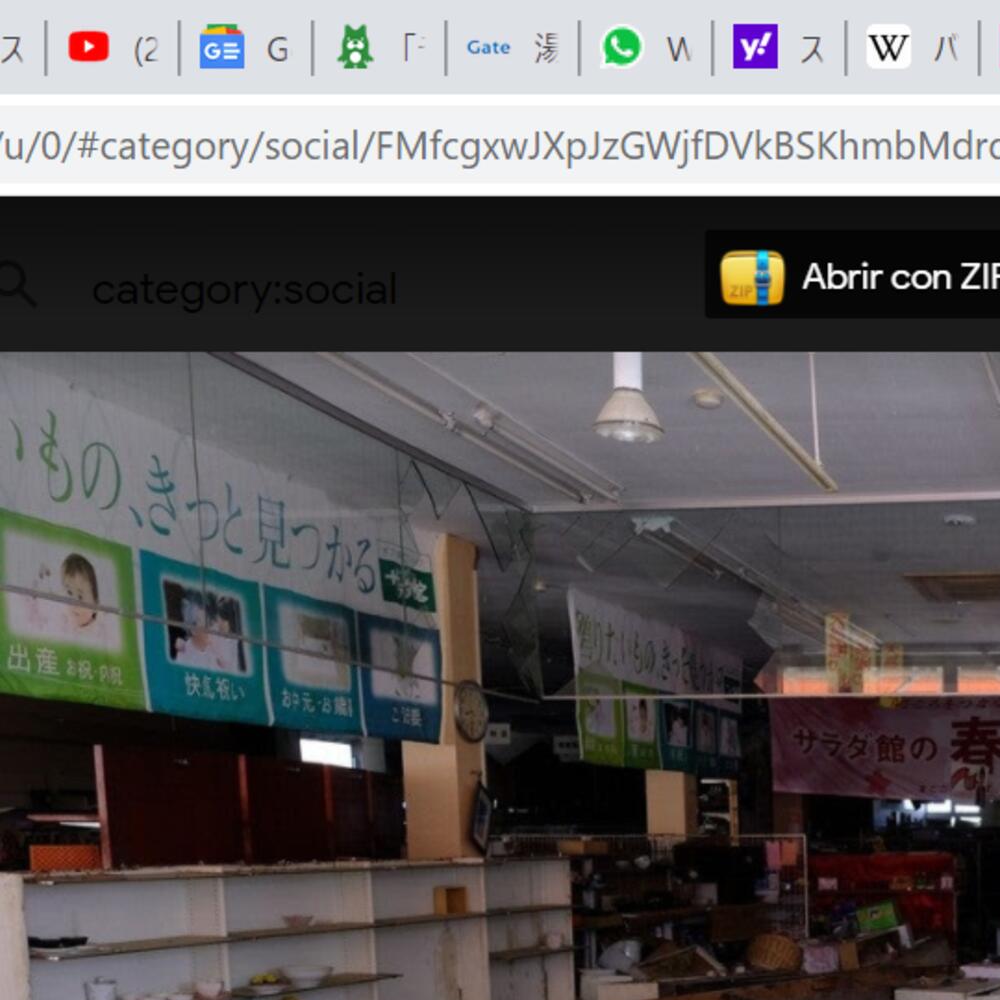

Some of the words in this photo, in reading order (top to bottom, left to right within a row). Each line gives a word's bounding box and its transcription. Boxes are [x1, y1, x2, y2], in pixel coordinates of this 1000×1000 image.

[267, 36, 288, 62] G
[467, 40, 511, 56] Gate
[801, 36, 824, 64] ス
[868, 34, 909, 62] W
[803, 261, 882, 290] Abrir
[891, 270, 951, 290] con
[94, 272, 396, 313] category:social
[8, 643, 61, 677] 出産
